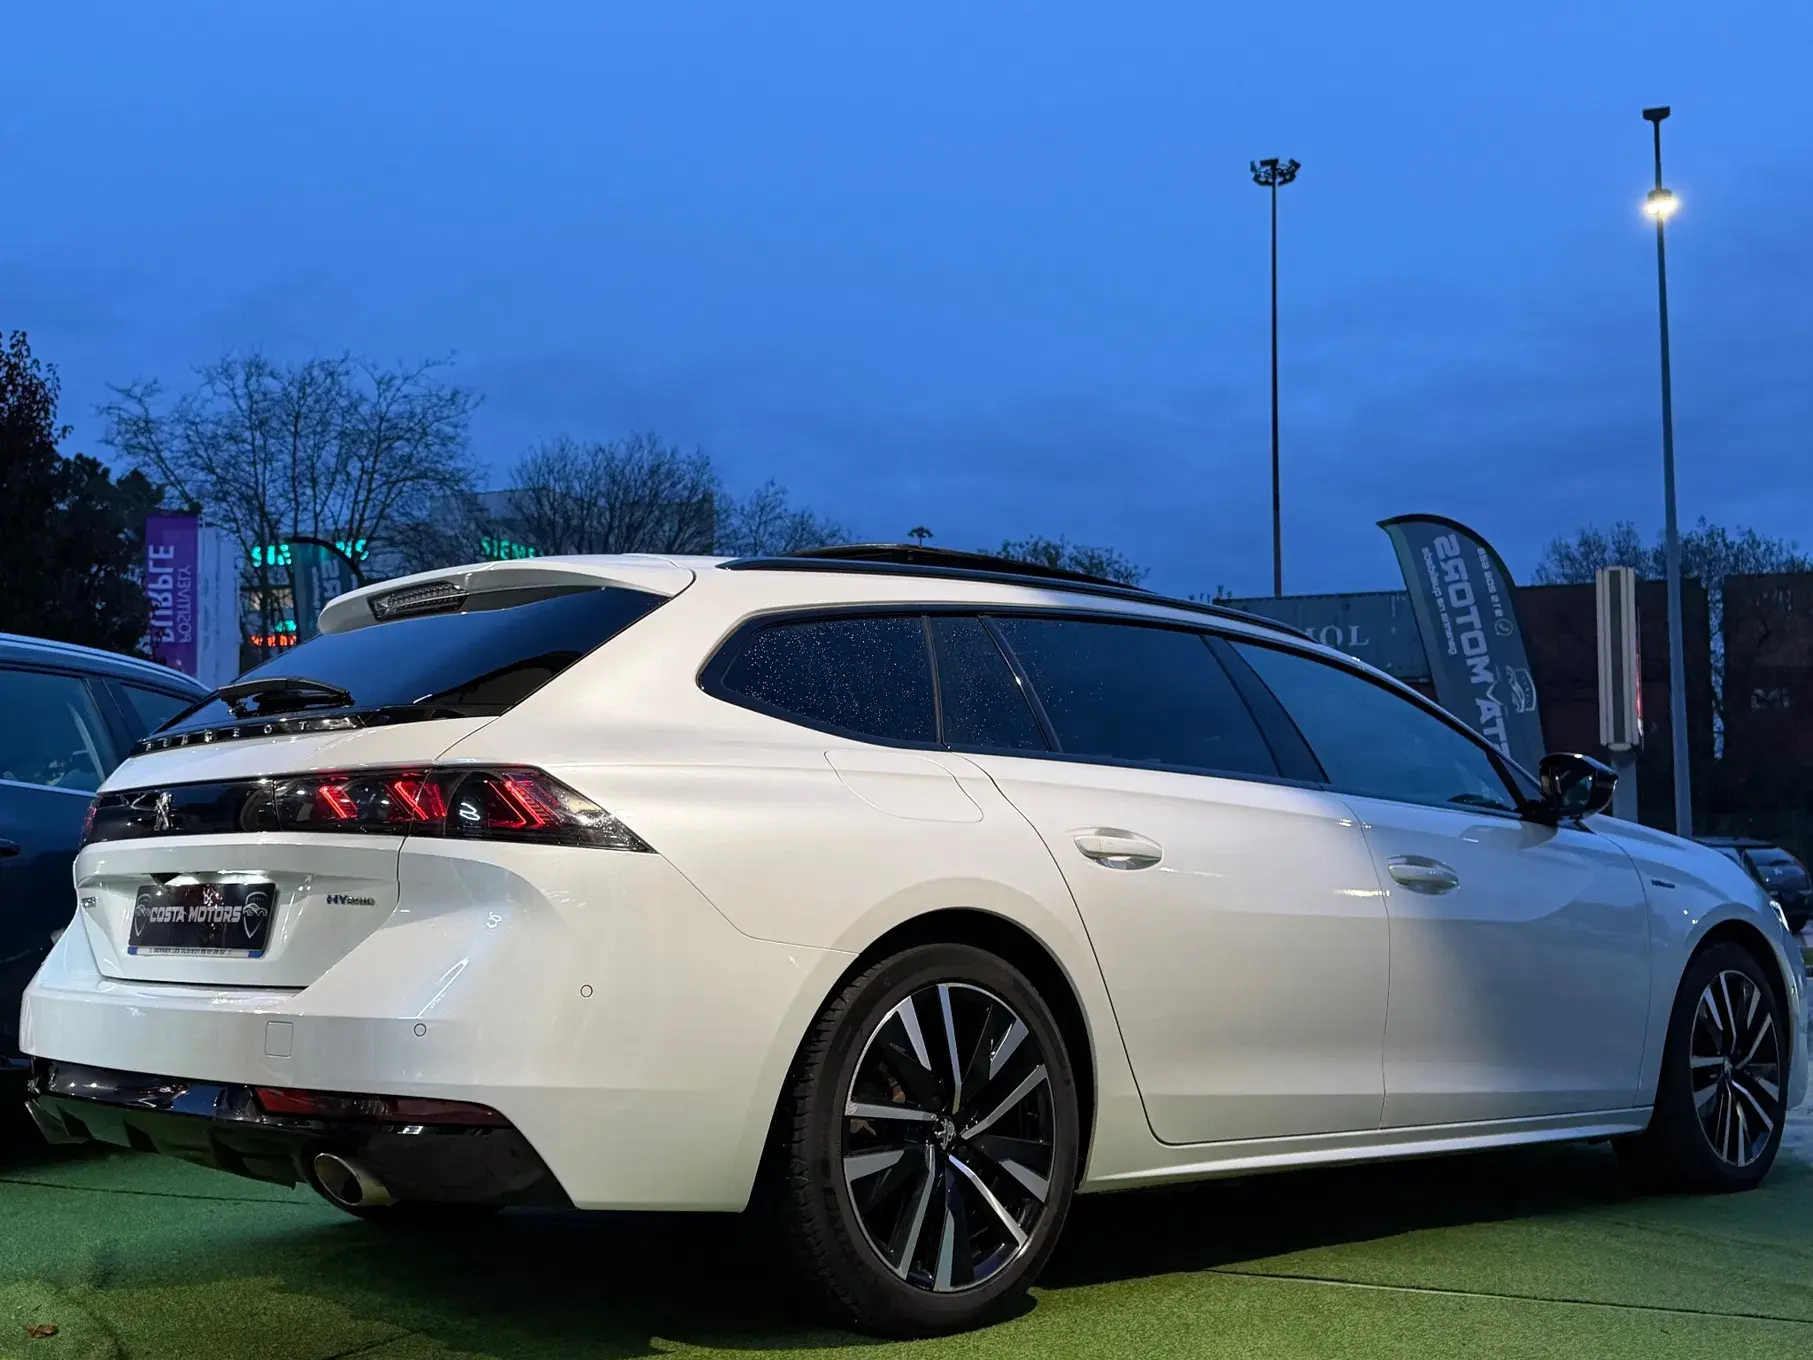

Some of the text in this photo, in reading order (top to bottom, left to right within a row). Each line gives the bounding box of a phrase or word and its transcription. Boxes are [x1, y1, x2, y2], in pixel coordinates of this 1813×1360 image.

[1305, 625, 1369, 647] OL
[149, 905, 243, 923] COSTA MOTORS
